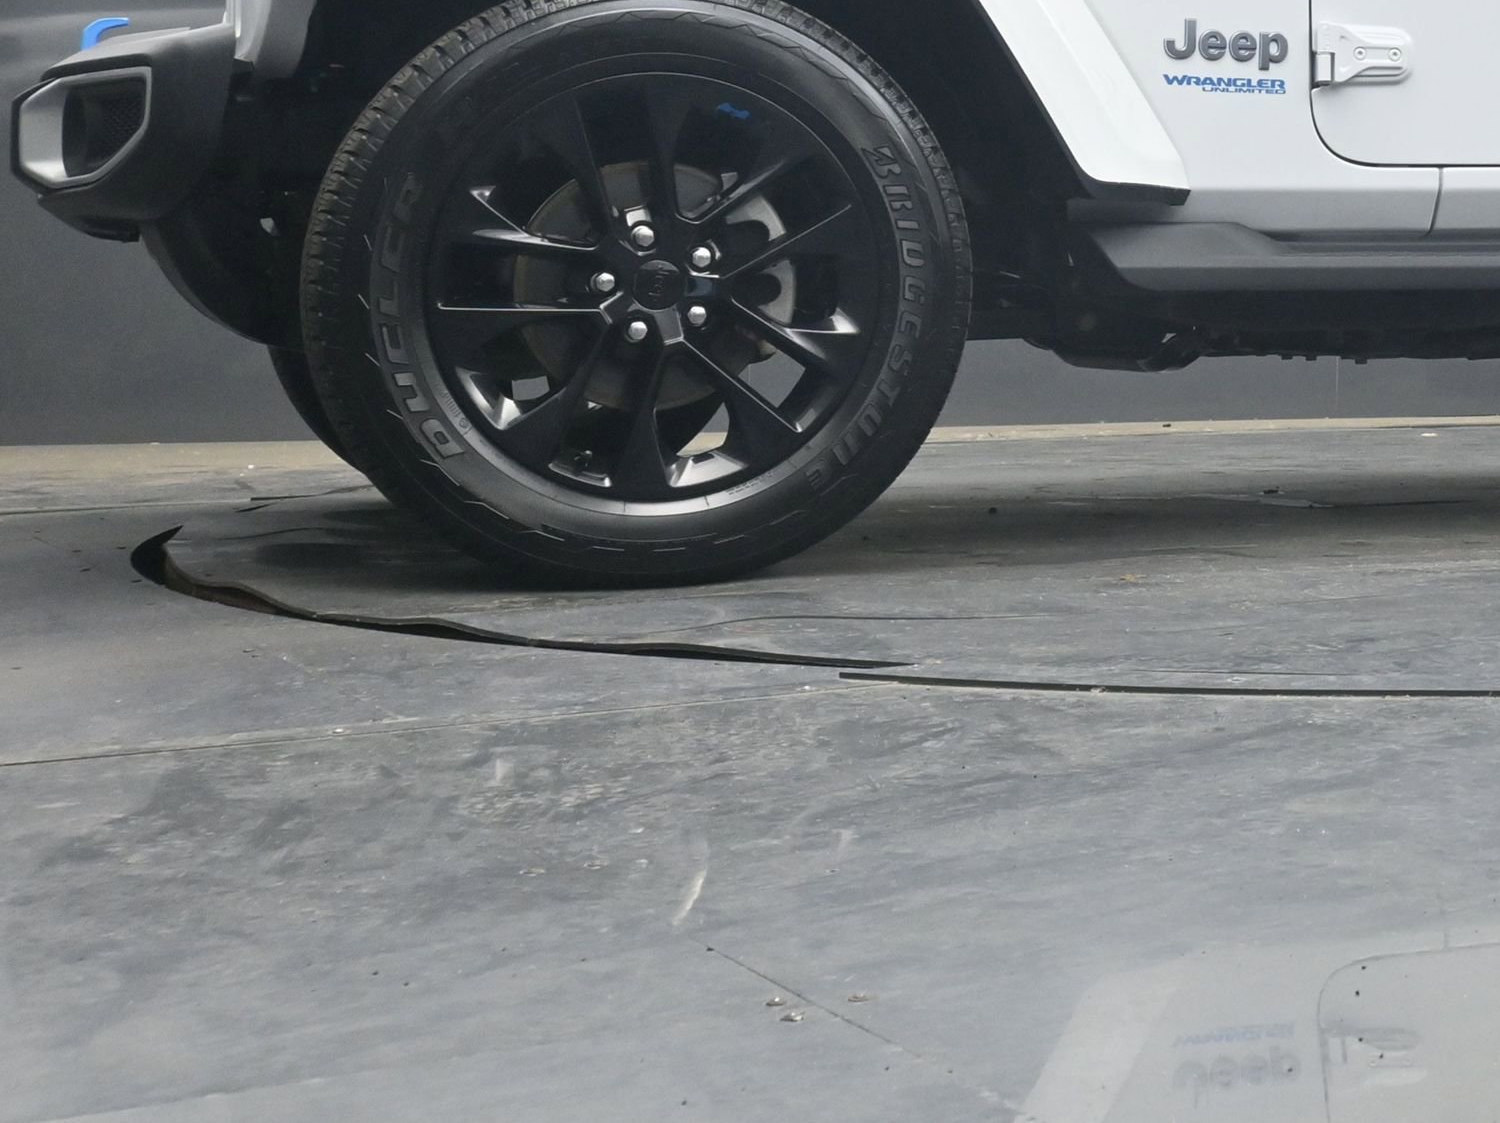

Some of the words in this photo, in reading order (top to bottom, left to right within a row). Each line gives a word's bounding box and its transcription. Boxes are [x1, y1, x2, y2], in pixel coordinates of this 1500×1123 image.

[1163, 18, 1288, 71] Jeep
[1163, 74, 1286, 90] WRANGLER
[1201, 86, 1286, 94] UNLIMITED
[378, 172, 465, 457] DUELER
[805, 145, 926, 488] BRIDGESTONE
